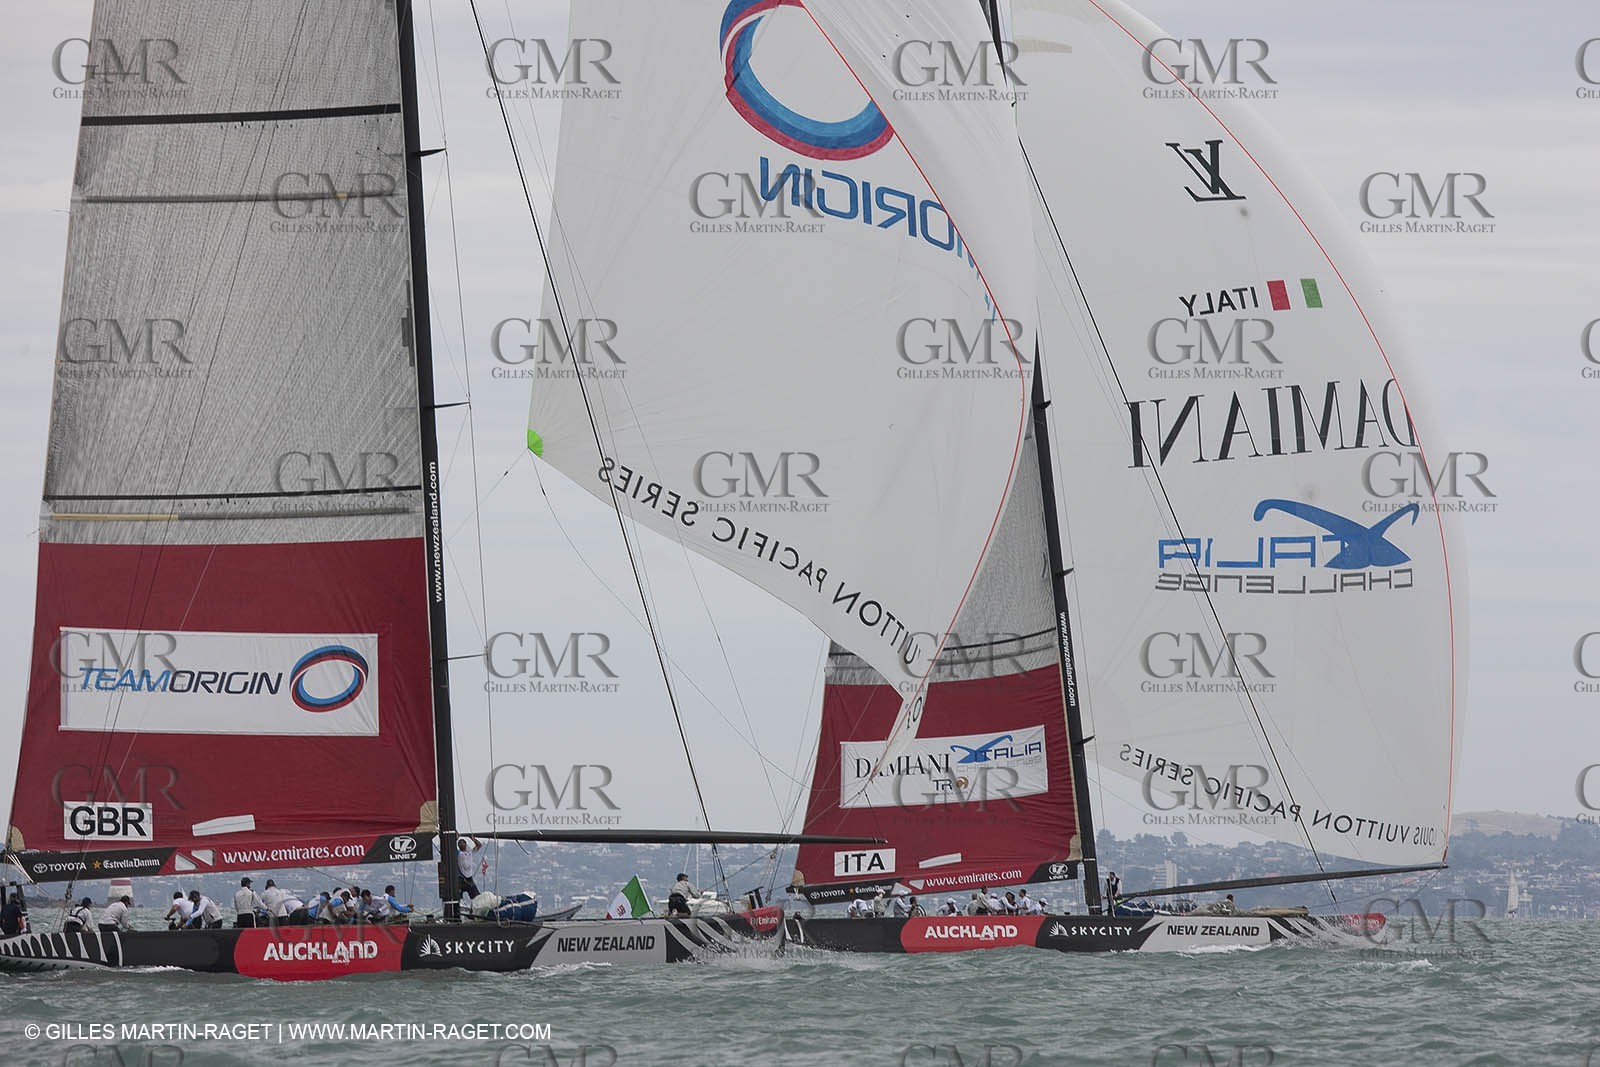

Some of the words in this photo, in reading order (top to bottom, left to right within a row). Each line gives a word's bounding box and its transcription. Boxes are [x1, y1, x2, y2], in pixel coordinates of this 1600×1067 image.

[429, 461, 442, 602] www.newzealand.com
[70, 806, 147, 837] GBR
[223, 844, 365, 863] www.emirates.com
[49, 862, 87, 871] TOYOTA
[844, 853, 885, 872] ITA
[926, 869, 1022, 887] www.emirates.com
[820, 889, 846, 898] TOYOTA
[925, 925, 1018, 939] AUCKLAND
[1071, 926, 1132, 936] SKYCITY
[1167, 925, 1198, 935] NEW
[1201, 925, 1260, 936] ZEALAND
[263, 940, 378, 961] AUCKLAND
[445, 940, 515, 954] SKYCITY
[557, 937, 591, 952] NEW
[593, 935, 655, 951] ZEALAND
